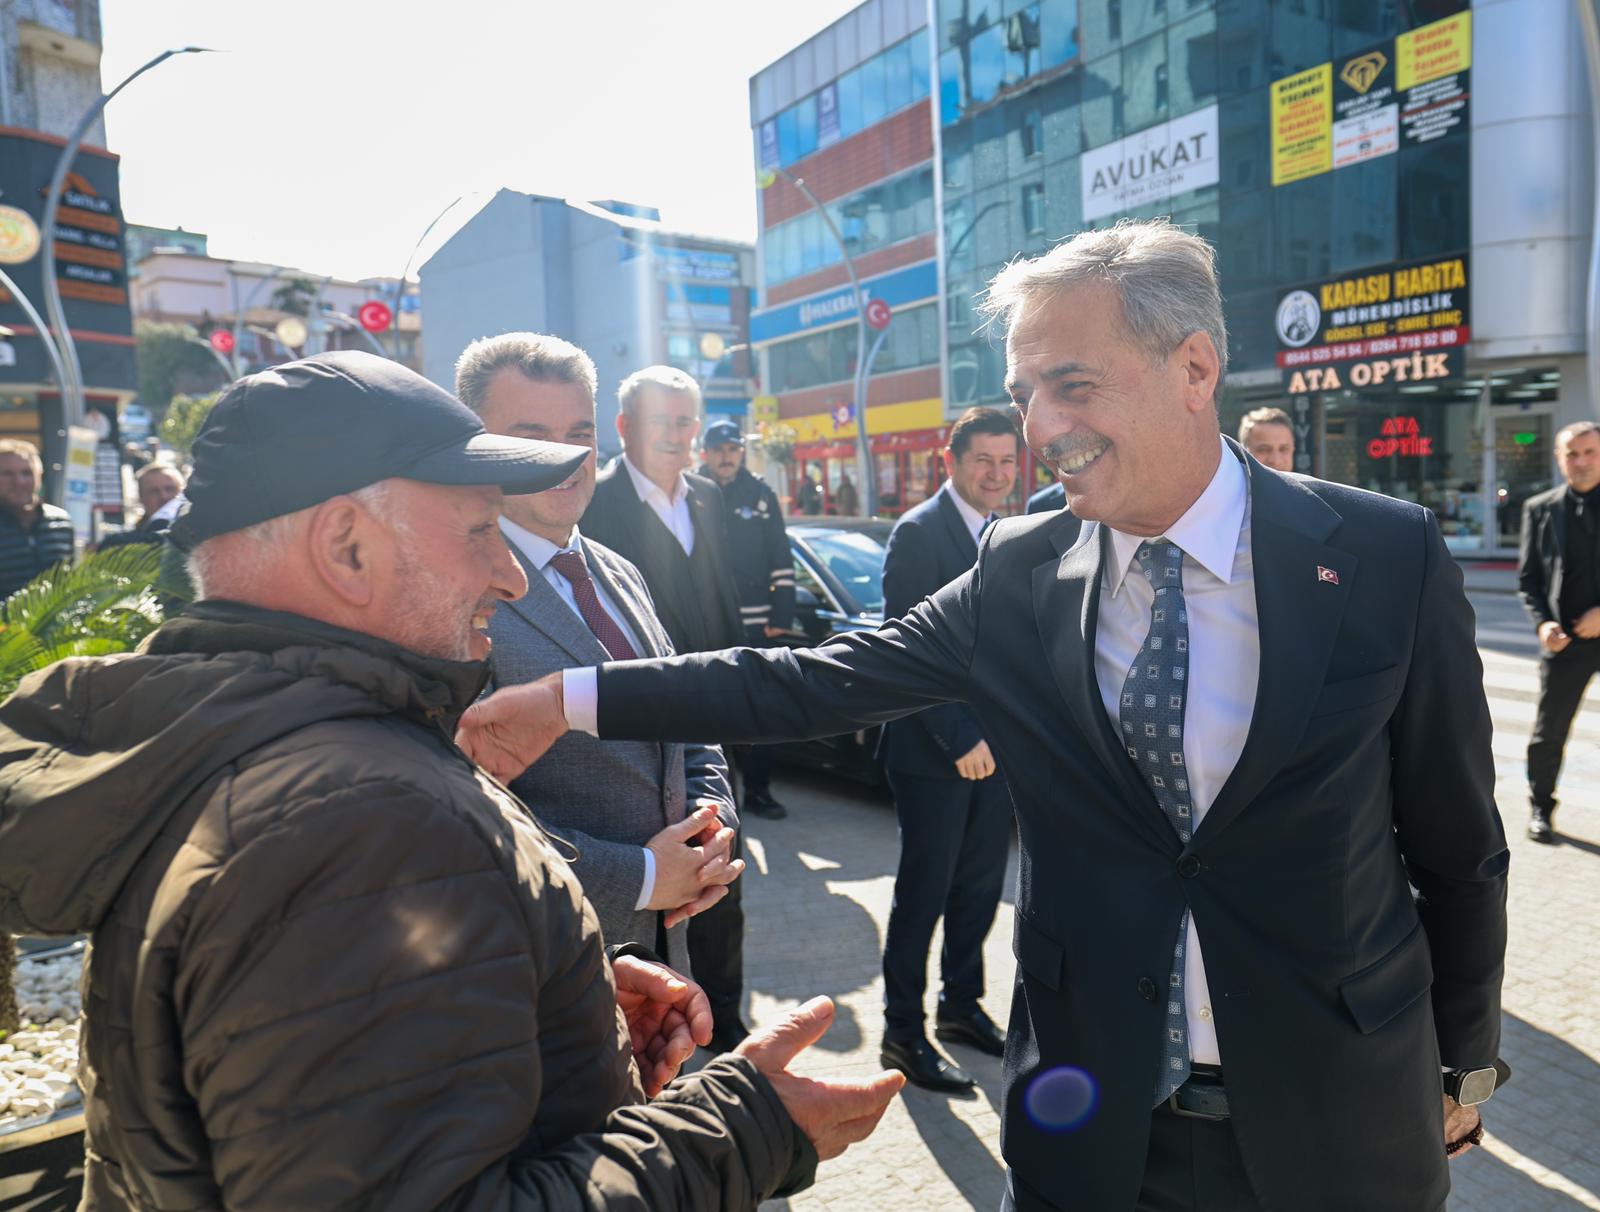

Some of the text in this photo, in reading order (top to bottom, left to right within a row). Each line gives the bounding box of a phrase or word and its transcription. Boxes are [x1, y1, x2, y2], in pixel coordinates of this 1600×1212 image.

[1091, 131, 1208, 195] AVUKAT
[1320, 259, 1466, 311] KARASU HARİTA
[1332, 294, 1453, 325] MÜHENDİSLİK
[1288, 350, 1450, 394] ATA OPTİK
[1381, 416, 1421, 436] ATA
[1367, 434, 1433, 459] OPTİK
